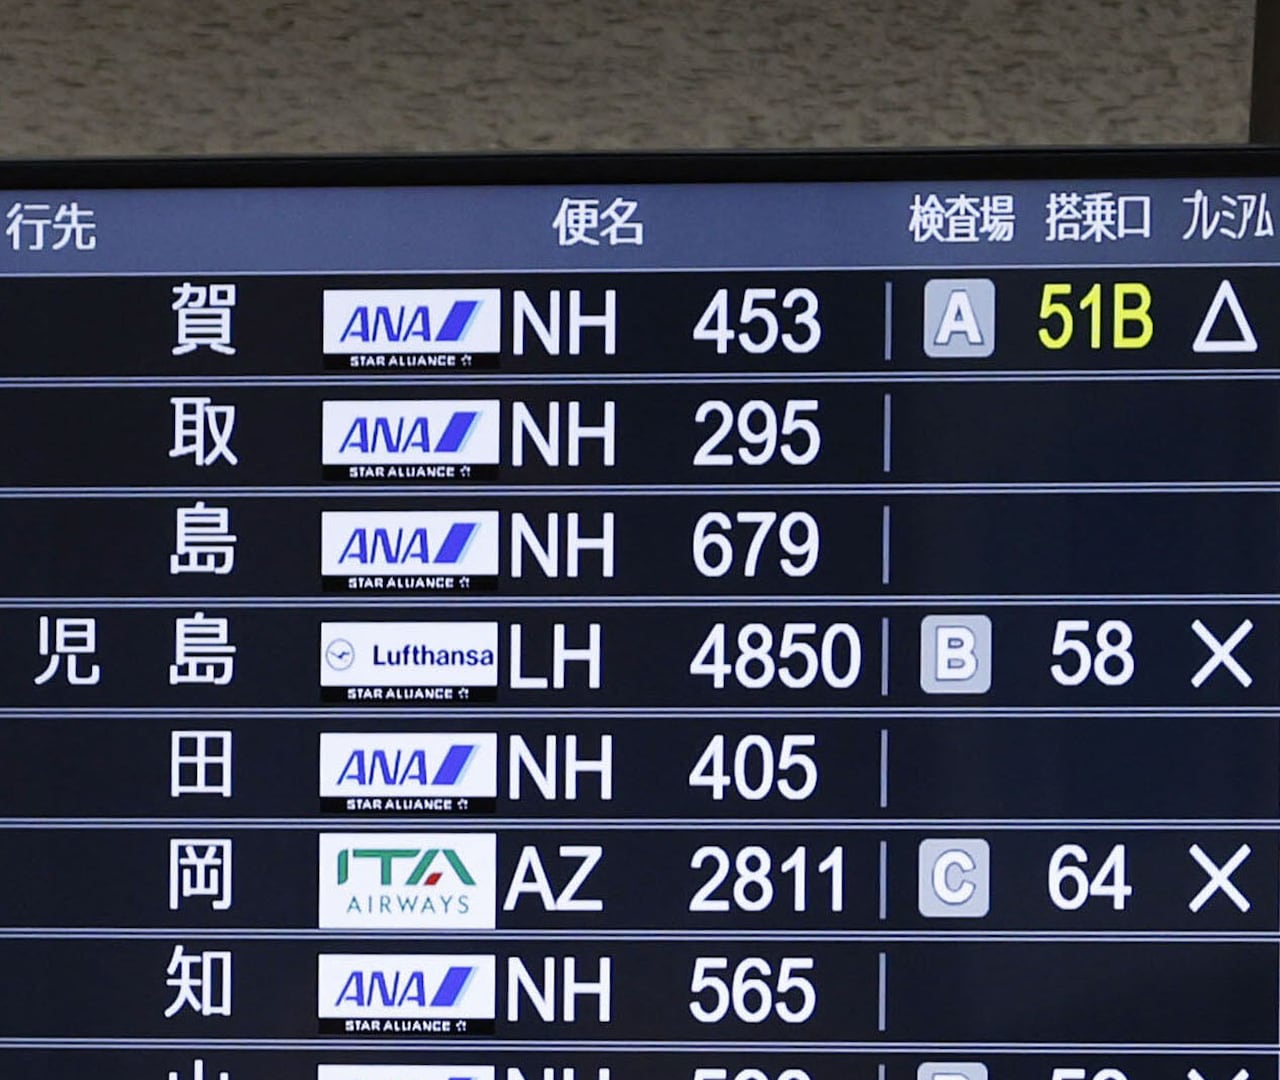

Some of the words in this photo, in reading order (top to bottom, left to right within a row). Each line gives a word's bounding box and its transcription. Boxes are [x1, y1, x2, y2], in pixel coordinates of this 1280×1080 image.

[5, 202, 97, 251] 行先
[552, 197, 643, 246] 便名
[908, 193, 1016, 243] 検査場
[1045, 192, 1151, 243] 搭乗口
[338, 305, 429, 341] ANA
[513, 290, 615, 355] NH
[693, 288, 821, 353] 453
[933, 289, 985, 346] A
[1038, 282, 1154, 349] 51B
[338, 416, 429, 452] ANA
[512, 401, 615, 466] NH
[693, 400, 820, 465] 295
[338, 528, 429, 564] ANA
[512, 513, 614, 577] NH
[693, 512, 819, 577] 679
[373, 644, 494, 666] Lufthansa
[511, 624, 600, 688] LH
[690, 623, 861, 688] 4850
[935, 625, 979, 681] B
[1050, 620, 1135, 686] 58
[336, 750, 427, 786] ANA
[510, 735, 612, 799] NH
[689, 735, 817, 799] 405
[346, 895, 470, 915] AIRWAYS
[504, 846, 602, 910] AZ
[690, 846, 844, 911] 2811
[932, 849, 977, 905] C
[1048, 844, 1133, 910] 64
[334, 971, 425, 1007] ANA
[508, 957, 610, 1021] NH
[690, 958, 815, 1022] 565
